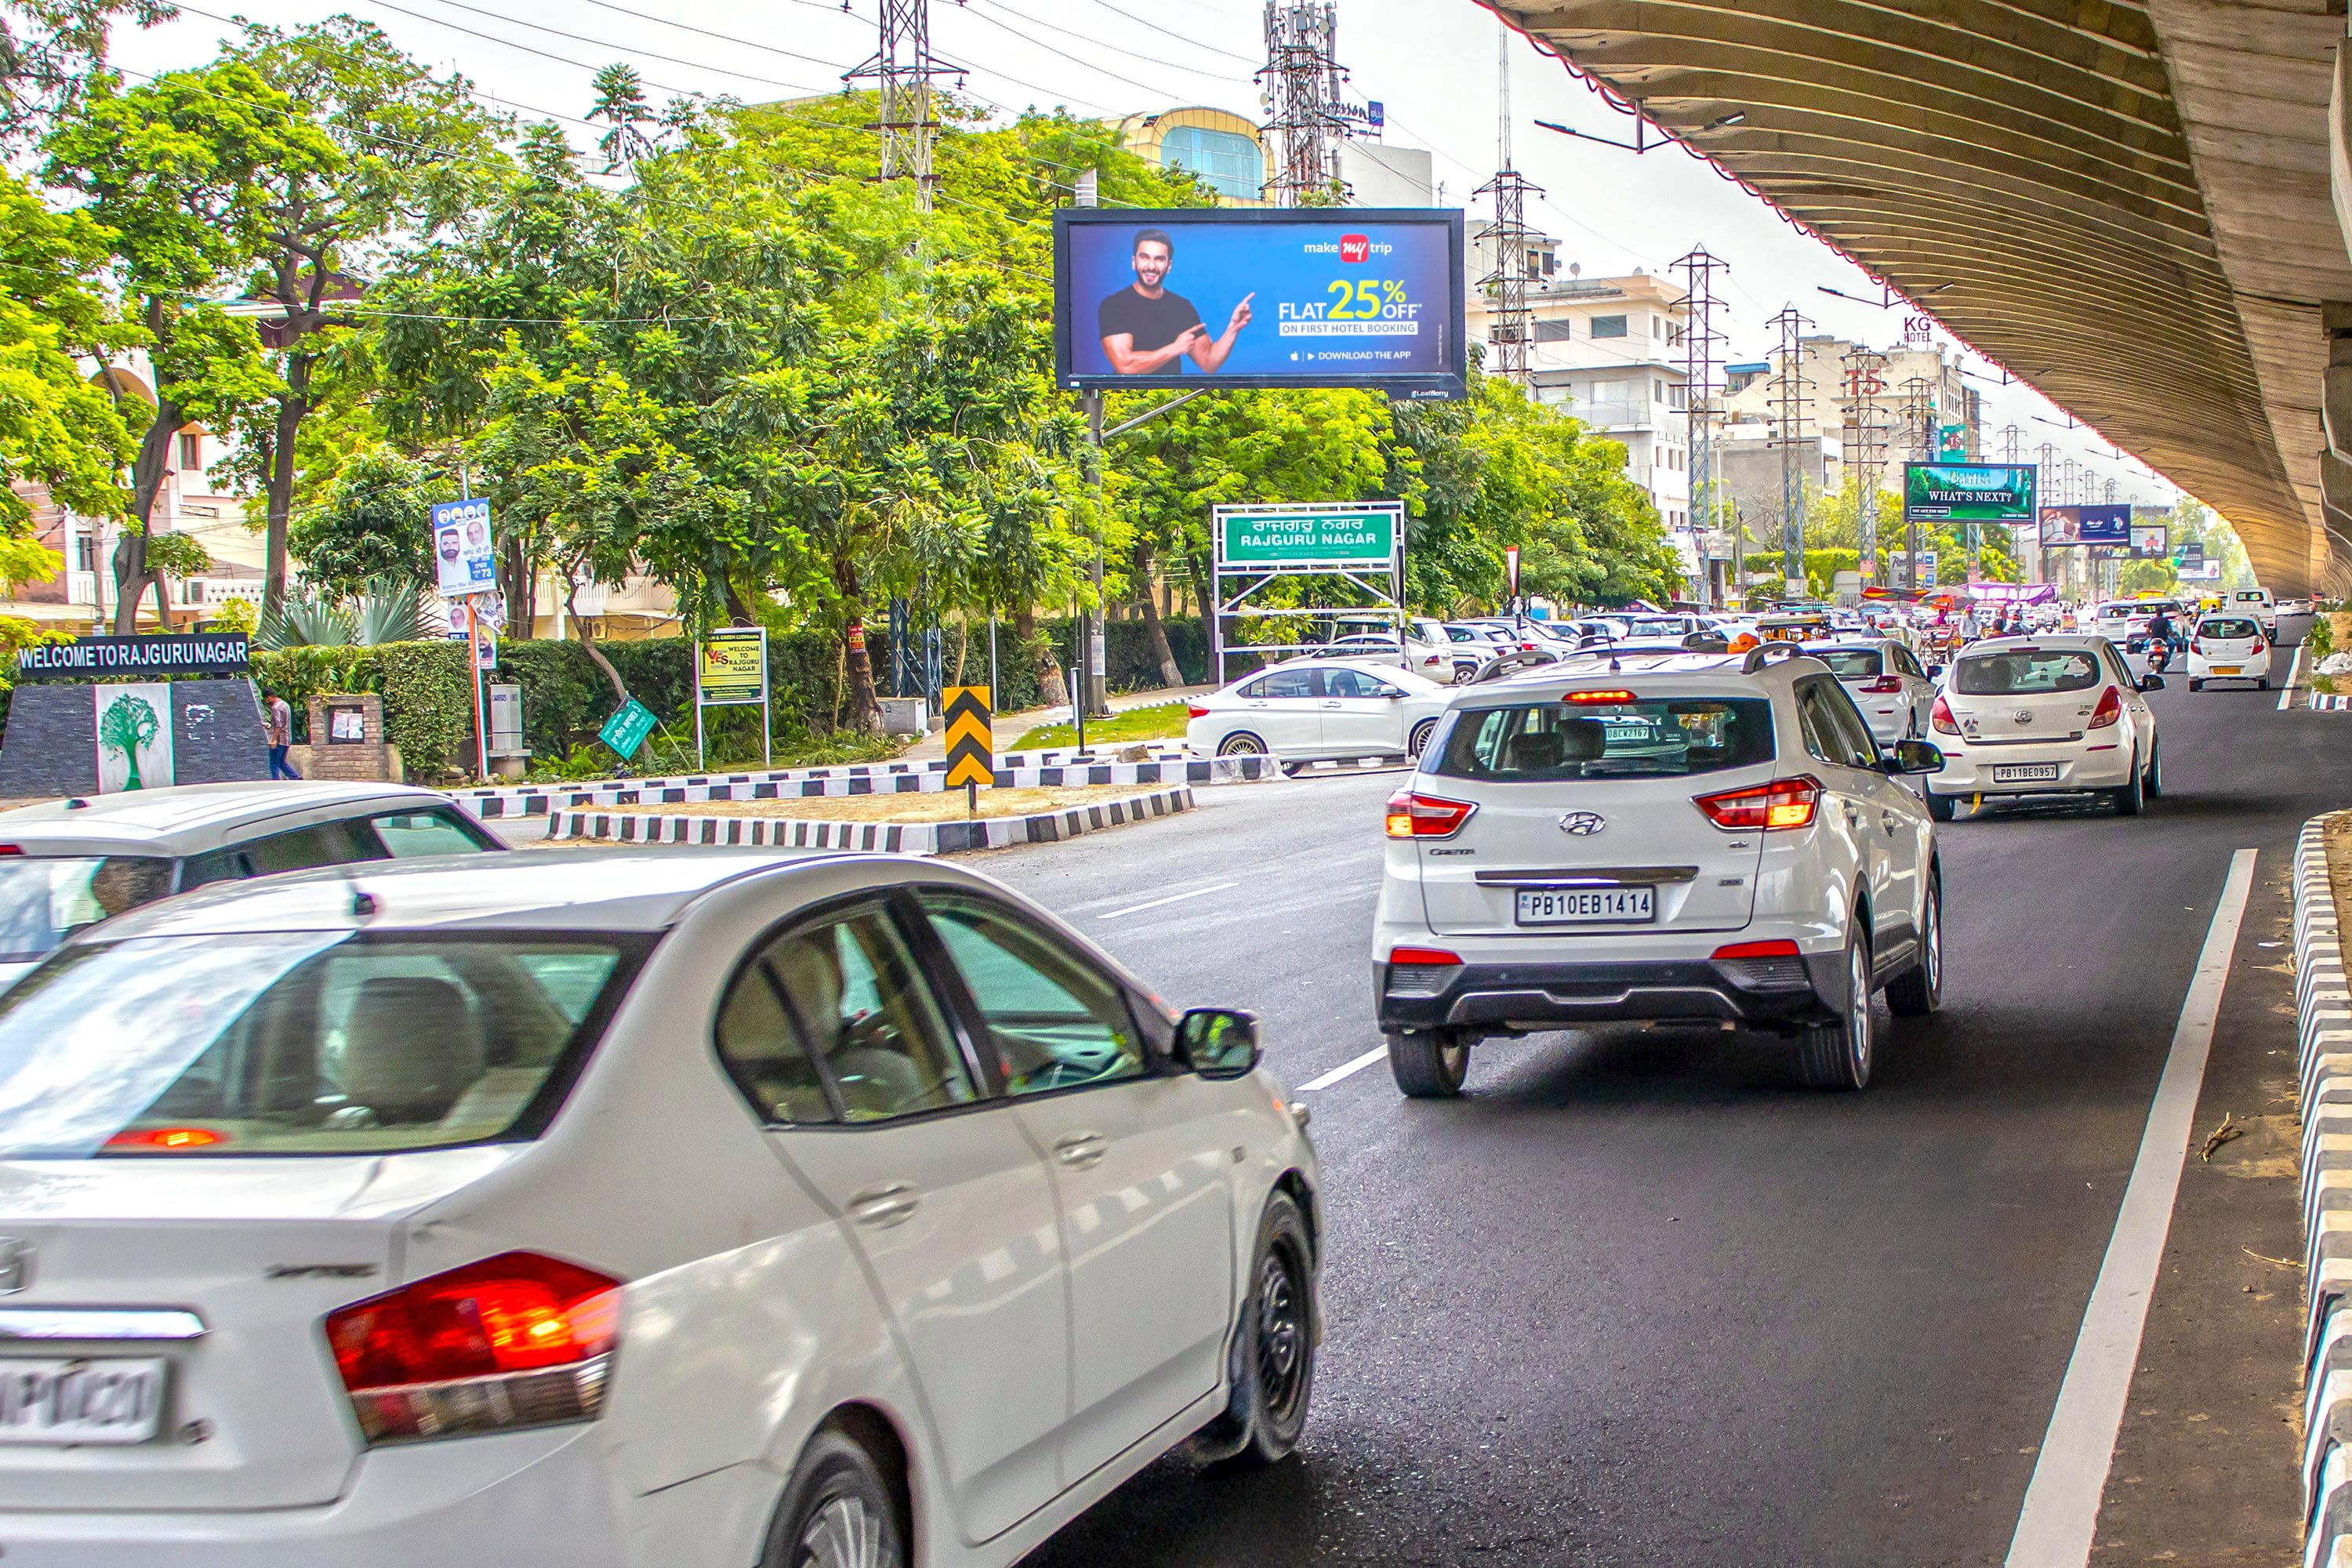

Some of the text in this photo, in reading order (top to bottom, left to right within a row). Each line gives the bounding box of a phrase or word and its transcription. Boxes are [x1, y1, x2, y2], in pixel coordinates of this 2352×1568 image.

[1305, 241, 1392, 261] make my trip
[1279, 303, 1327, 320] FLAT
[1327, 280, 1406, 320] 25%
[1283, 323, 1415, 334] ON FIRST HOTEL BOOKING
[1904, 317, 1931, 331] KG
[1904, 332, 1932, 343] HOTEL
[1319, 351, 1410, 361] DOWNLOAD THE APP
[1846, 368, 1881, 395] T5
[1929, 491, 2013, 503] WHAT'S NEXT?
[1321, 518, 1365, 530] ਨਗਰ
[1240, 533, 1377, 546] RAJGURU NAGAR
[481, 568, 492, 578] 73
[1607, 728, 1648, 739] 08CW2167
[2001, 766, 2055, 779] PB11BE0957
[1531, 893, 1650, 916] PB10EB1414
